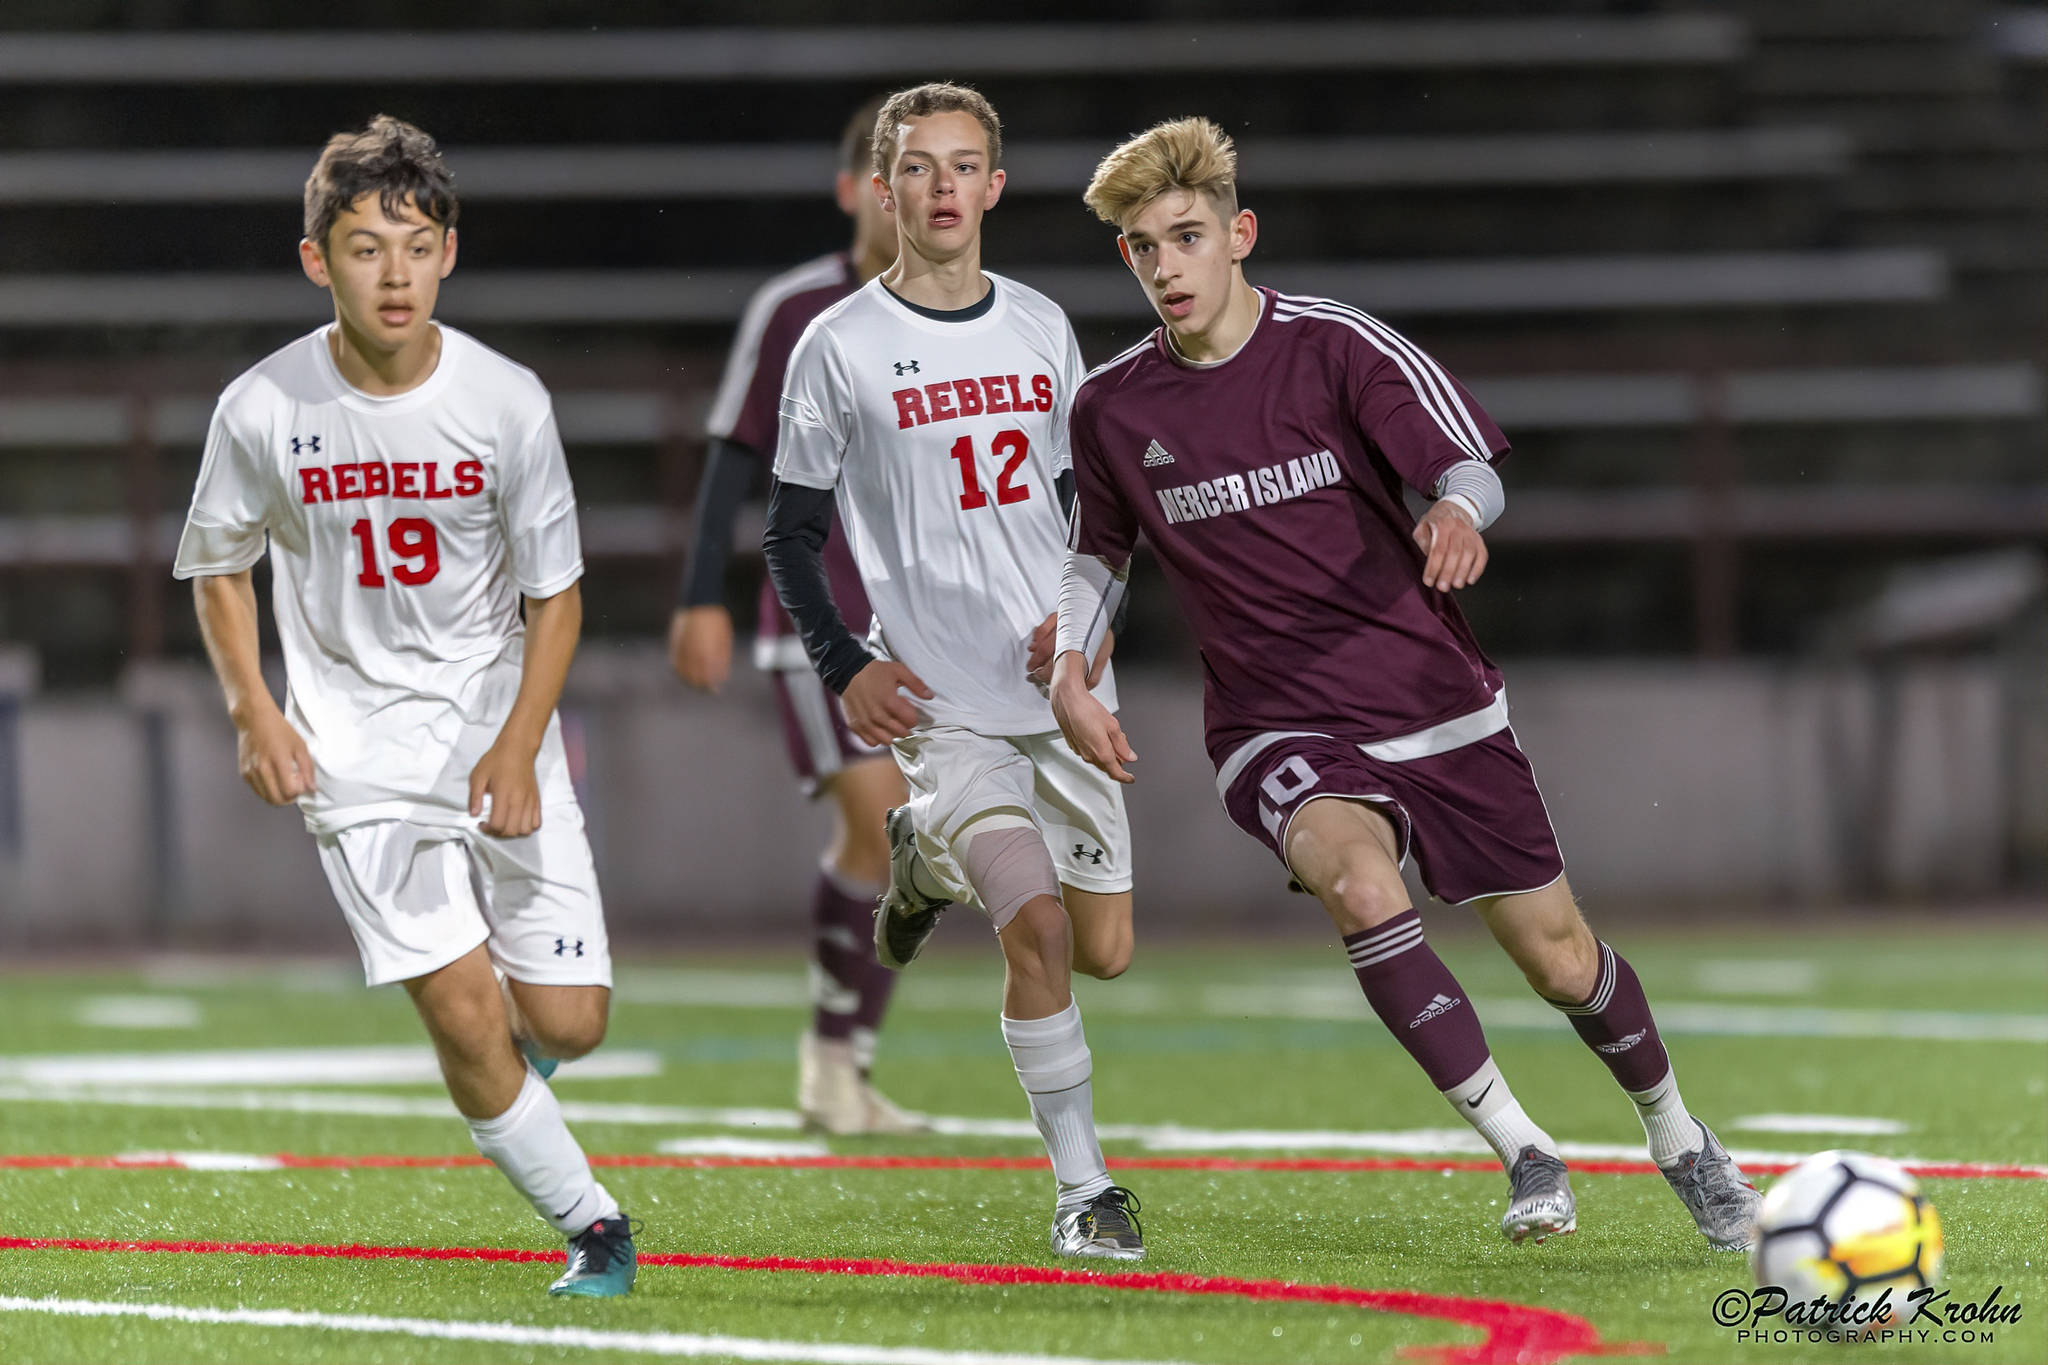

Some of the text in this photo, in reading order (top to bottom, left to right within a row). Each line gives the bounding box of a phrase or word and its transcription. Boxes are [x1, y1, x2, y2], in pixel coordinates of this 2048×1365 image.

[892, 374, 1053, 430] REBELS
[298, 460, 484, 504] REBELS
[950, 429, 1031, 511] 12
[1143, 454, 1175, 467] adidas
[1155, 449, 1342, 525] MERCER ISLAND
[351, 517, 441, 588] 19
[1409, 997, 1461, 1029] adidas
